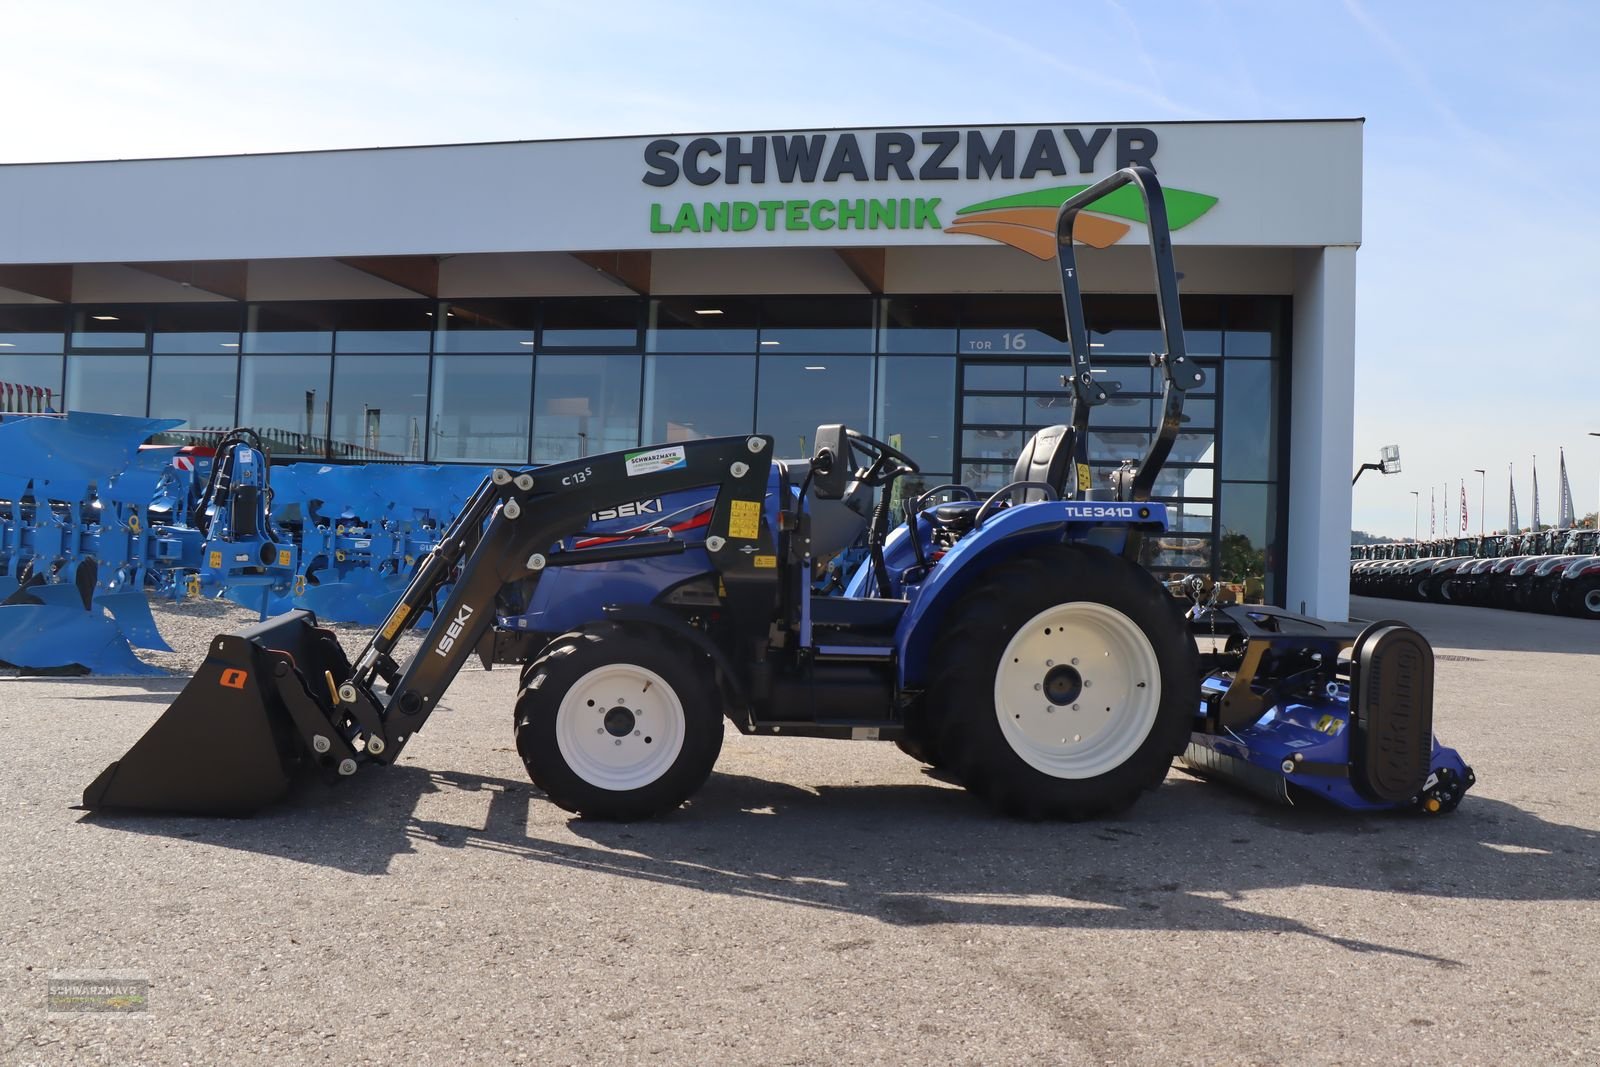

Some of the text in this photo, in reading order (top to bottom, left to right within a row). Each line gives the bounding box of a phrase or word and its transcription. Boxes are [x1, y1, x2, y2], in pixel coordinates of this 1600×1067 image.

[642, 128, 1159, 187] SCHWARZMAYR
[650, 198, 942, 233] LANDTECHNIK
[969, 332, 1026, 350] TOR 16
[631, 452, 677, 464] SCHWARZMAYR
[591, 498, 663, 521] ISEKI
[435, 604, 473, 657] ISEKI
